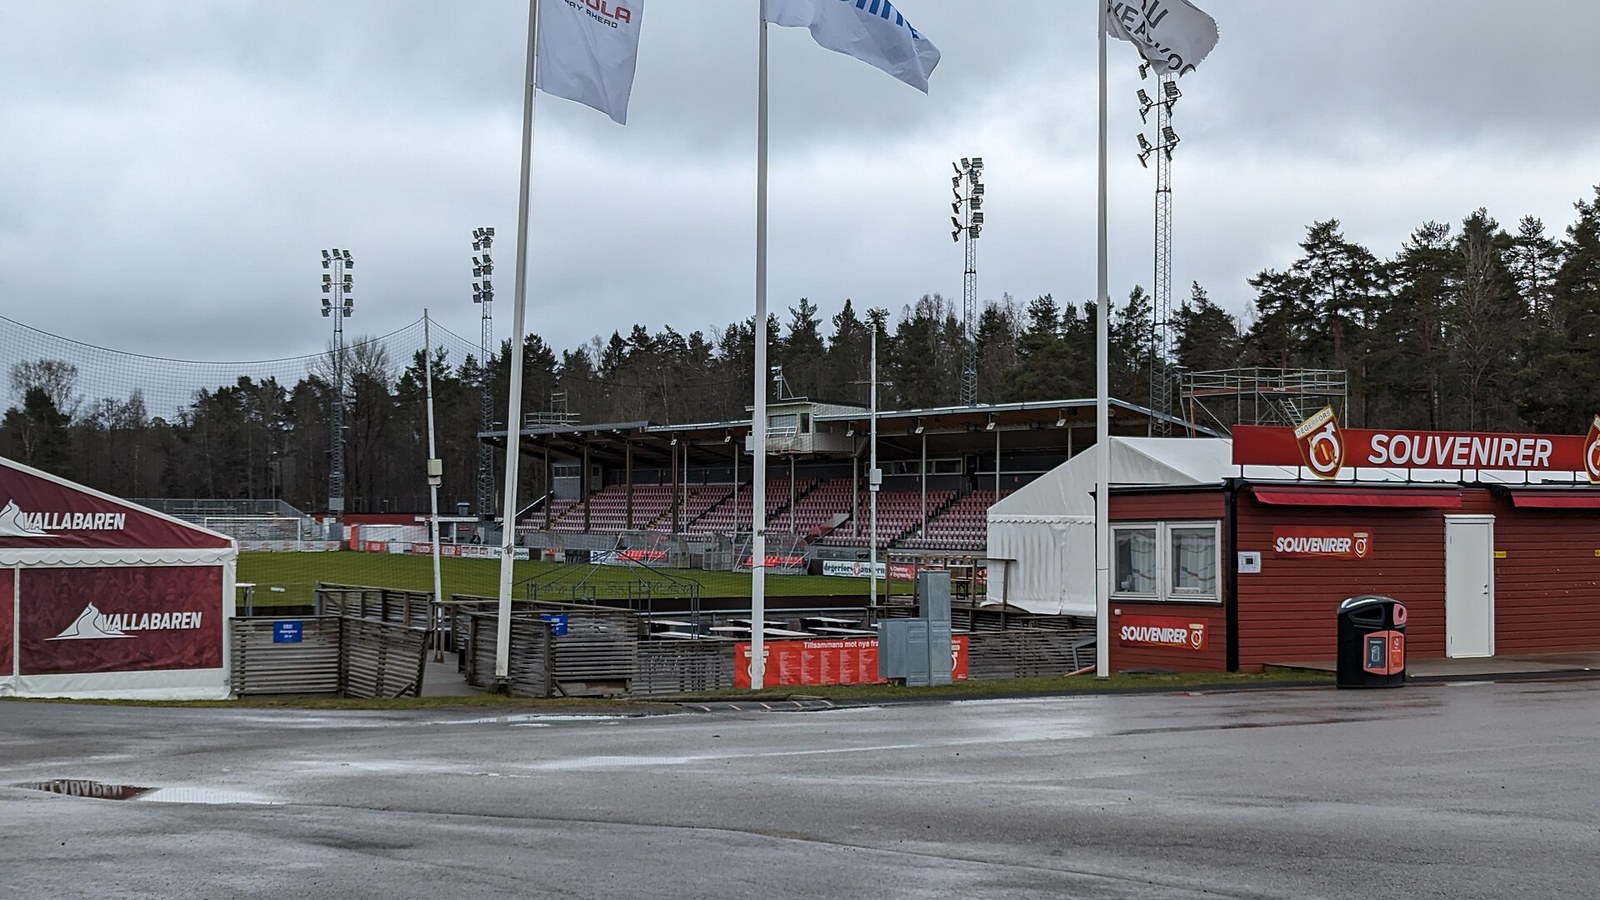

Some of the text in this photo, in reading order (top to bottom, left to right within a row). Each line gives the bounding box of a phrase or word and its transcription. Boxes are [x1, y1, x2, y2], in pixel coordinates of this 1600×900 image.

[564, 0, 618, 29] AY AHEAD
[1368, 434, 1553, 467] SOUVENIRER
[22, 512, 126, 530] VALLABAREN
[1276, 536, 1351, 553] SOUVENIRER
[103, 611, 203, 631] VALLABAREN
[1121, 625, 1188, 644] SOUVENIRER
[803, 641, 843, 650] Tillsammans
[844, 641, 857, 649] mot
[858, 641, 870, 650] nya
